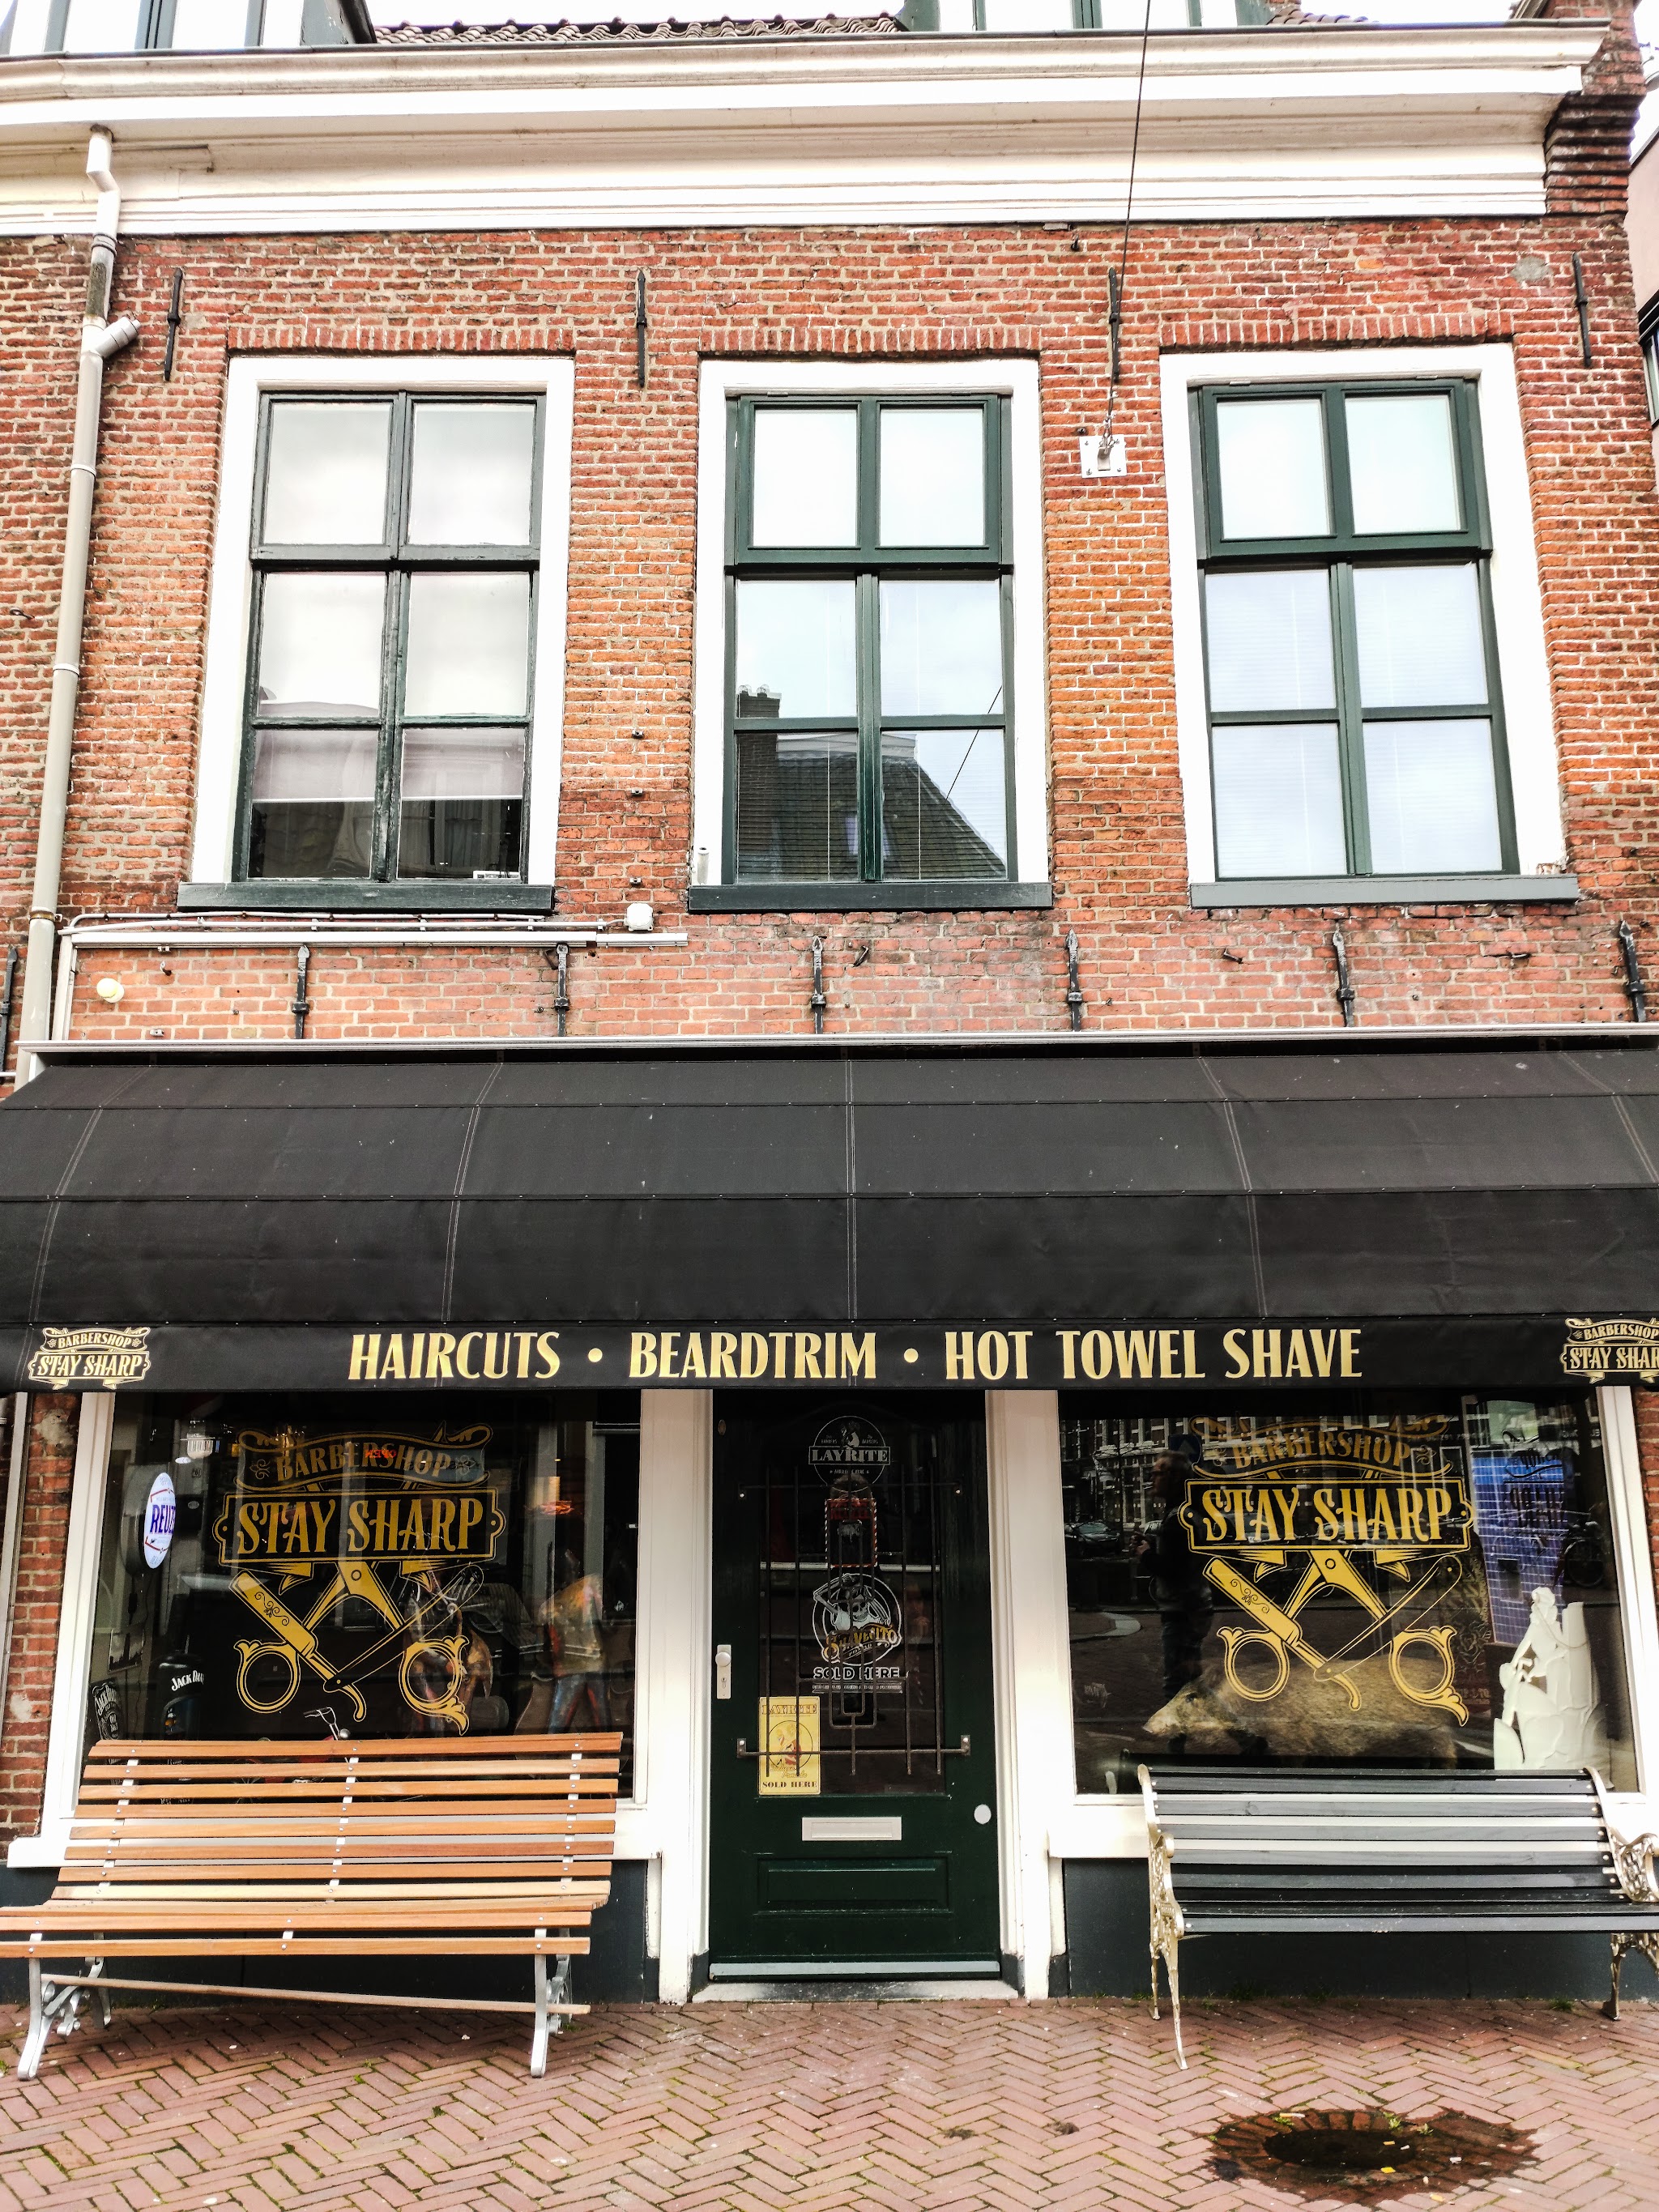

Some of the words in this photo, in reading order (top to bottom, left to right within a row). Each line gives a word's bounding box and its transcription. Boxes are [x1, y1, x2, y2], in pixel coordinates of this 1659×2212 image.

[58, 1333, 132, 1349] BARBERSHOP
[1584, 1323, 1659, 1340] BARBERSHOP
[349, 1332, 561, 1379] HAIRCUTS
[629, 1331, 876, 1379] BEARDTRIM
[945, 1331, 1033, 1379] HOT
[1056, 1330, 1205, 1379] TOWEL
[1222, 1328, 1363, 1379] SHAVE
[1570, 1347, 1612, 1369] STAY
[1616, 1347, 1659, 1369] SHAR
[37, 1355, 81, 1376] STAY
[83, 1355, 143, 1376] SHARP
[812, 1449, 888, 1463] LAYRITE
[1232, 1430, 1411, 1469] BARBERSHOP
[276, 1442, 452, 1481] BARBERSHOP
[150, 1503, 176, 1534] REUZ
[1202, 1487, 1299, 1541] STAY
[1314, 1488, 1452, 1542] SHARP
[237, 1498, 336, 1554] STAY
[347, 1498, 484, 1552] SHARP
[171, 1677, 192, 1691] JACK
[812, 1666, 856, 1681] SOLD
[859, 1666, 901, 1681] HERE
